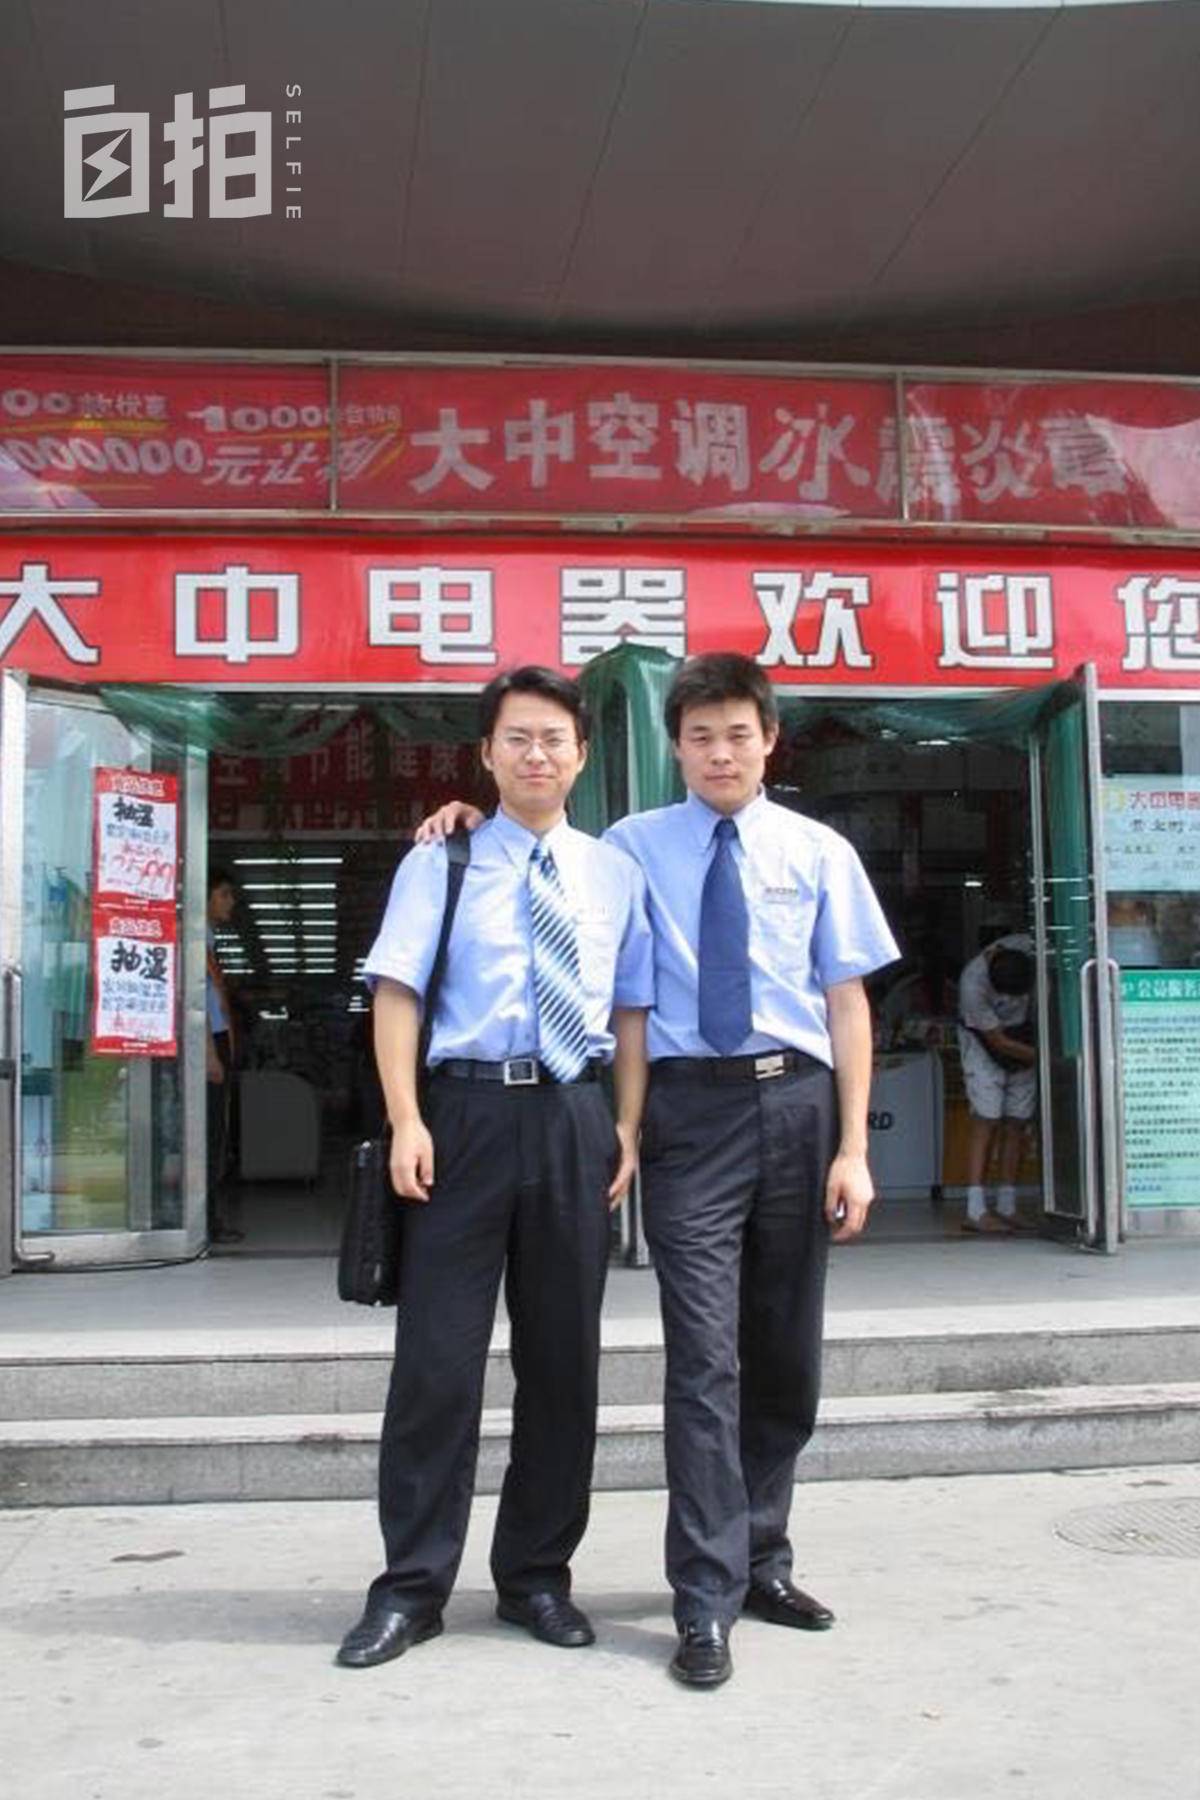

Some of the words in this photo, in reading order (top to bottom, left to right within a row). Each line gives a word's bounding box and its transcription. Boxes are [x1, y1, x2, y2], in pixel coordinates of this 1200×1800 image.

[0, 562, 1200, 672] 大中电器欢迎您
[111, 940, 168, 983] 抽湿
